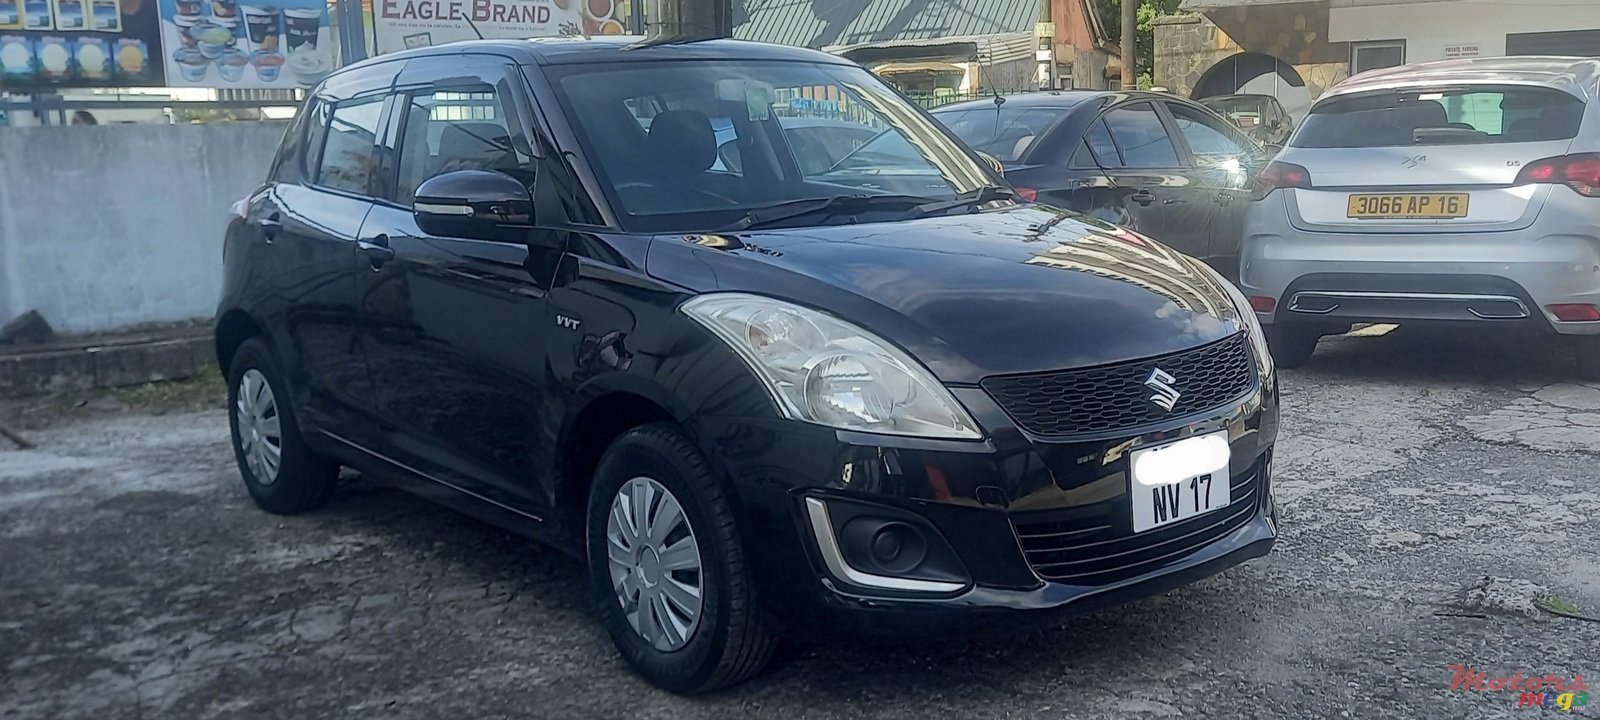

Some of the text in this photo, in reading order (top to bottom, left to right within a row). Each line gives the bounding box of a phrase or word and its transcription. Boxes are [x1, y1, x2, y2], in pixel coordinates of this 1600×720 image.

[381, 0, 551, 24] EAGLE BRAND
[1357, 196, 1459, 214] 3066 AP 16
[556, 315, 580, 330] VVT
[1153, 473, 1211, 524] NV 17
